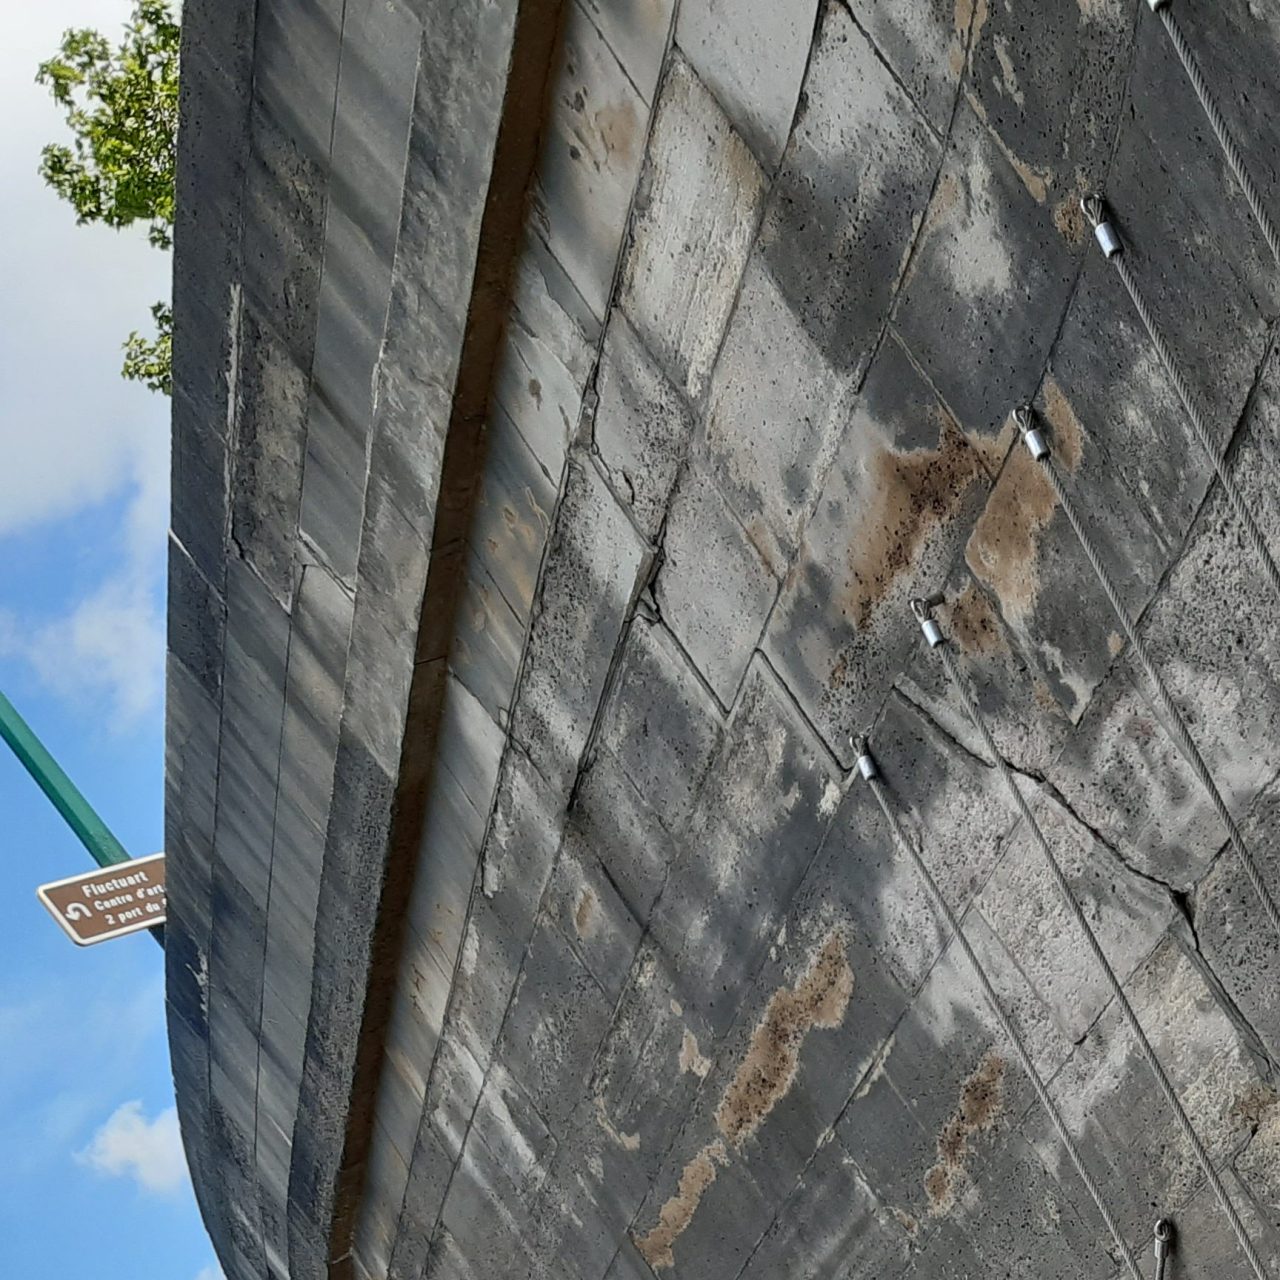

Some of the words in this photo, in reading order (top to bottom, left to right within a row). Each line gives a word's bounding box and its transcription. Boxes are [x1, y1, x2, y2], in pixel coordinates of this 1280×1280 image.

[81, 871, 148, 897] Fluctuart
[94, 894, 133, 910] Centre
[105, 914, 115, 925] 2
[118, 907, 143, 923] port
[145, 902, 161, 913] du
